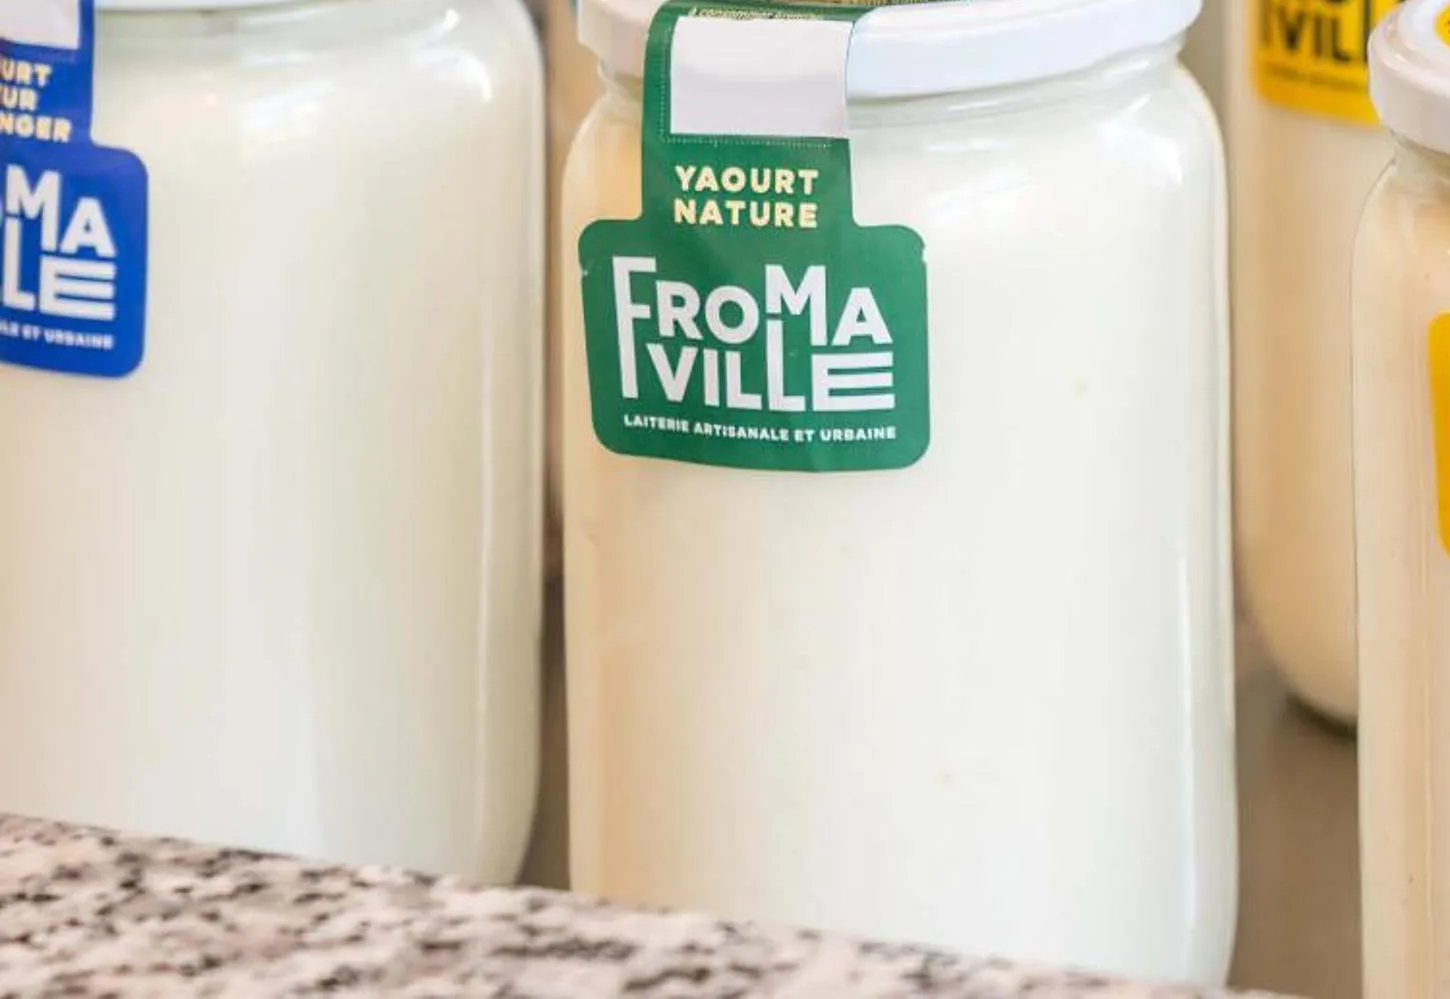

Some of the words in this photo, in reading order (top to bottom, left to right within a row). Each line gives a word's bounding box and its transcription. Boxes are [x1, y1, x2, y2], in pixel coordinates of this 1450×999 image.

[0, 85, 38, 112] UR
[674, 164, 820, 195] YAOURT
[0, 164, 116, 259] MA
[673, 198, 819, 230] NATURE
[611, 255, 894, 400] FROMA
[645, 318, 896, 412] VILLE
[623, 413, 690, 433] LAITERIE
[693, 421, 789, 441] ARTISANALE
[794, 427, 814, 442] ET
[819, 425, 897, 442] URBAINE
